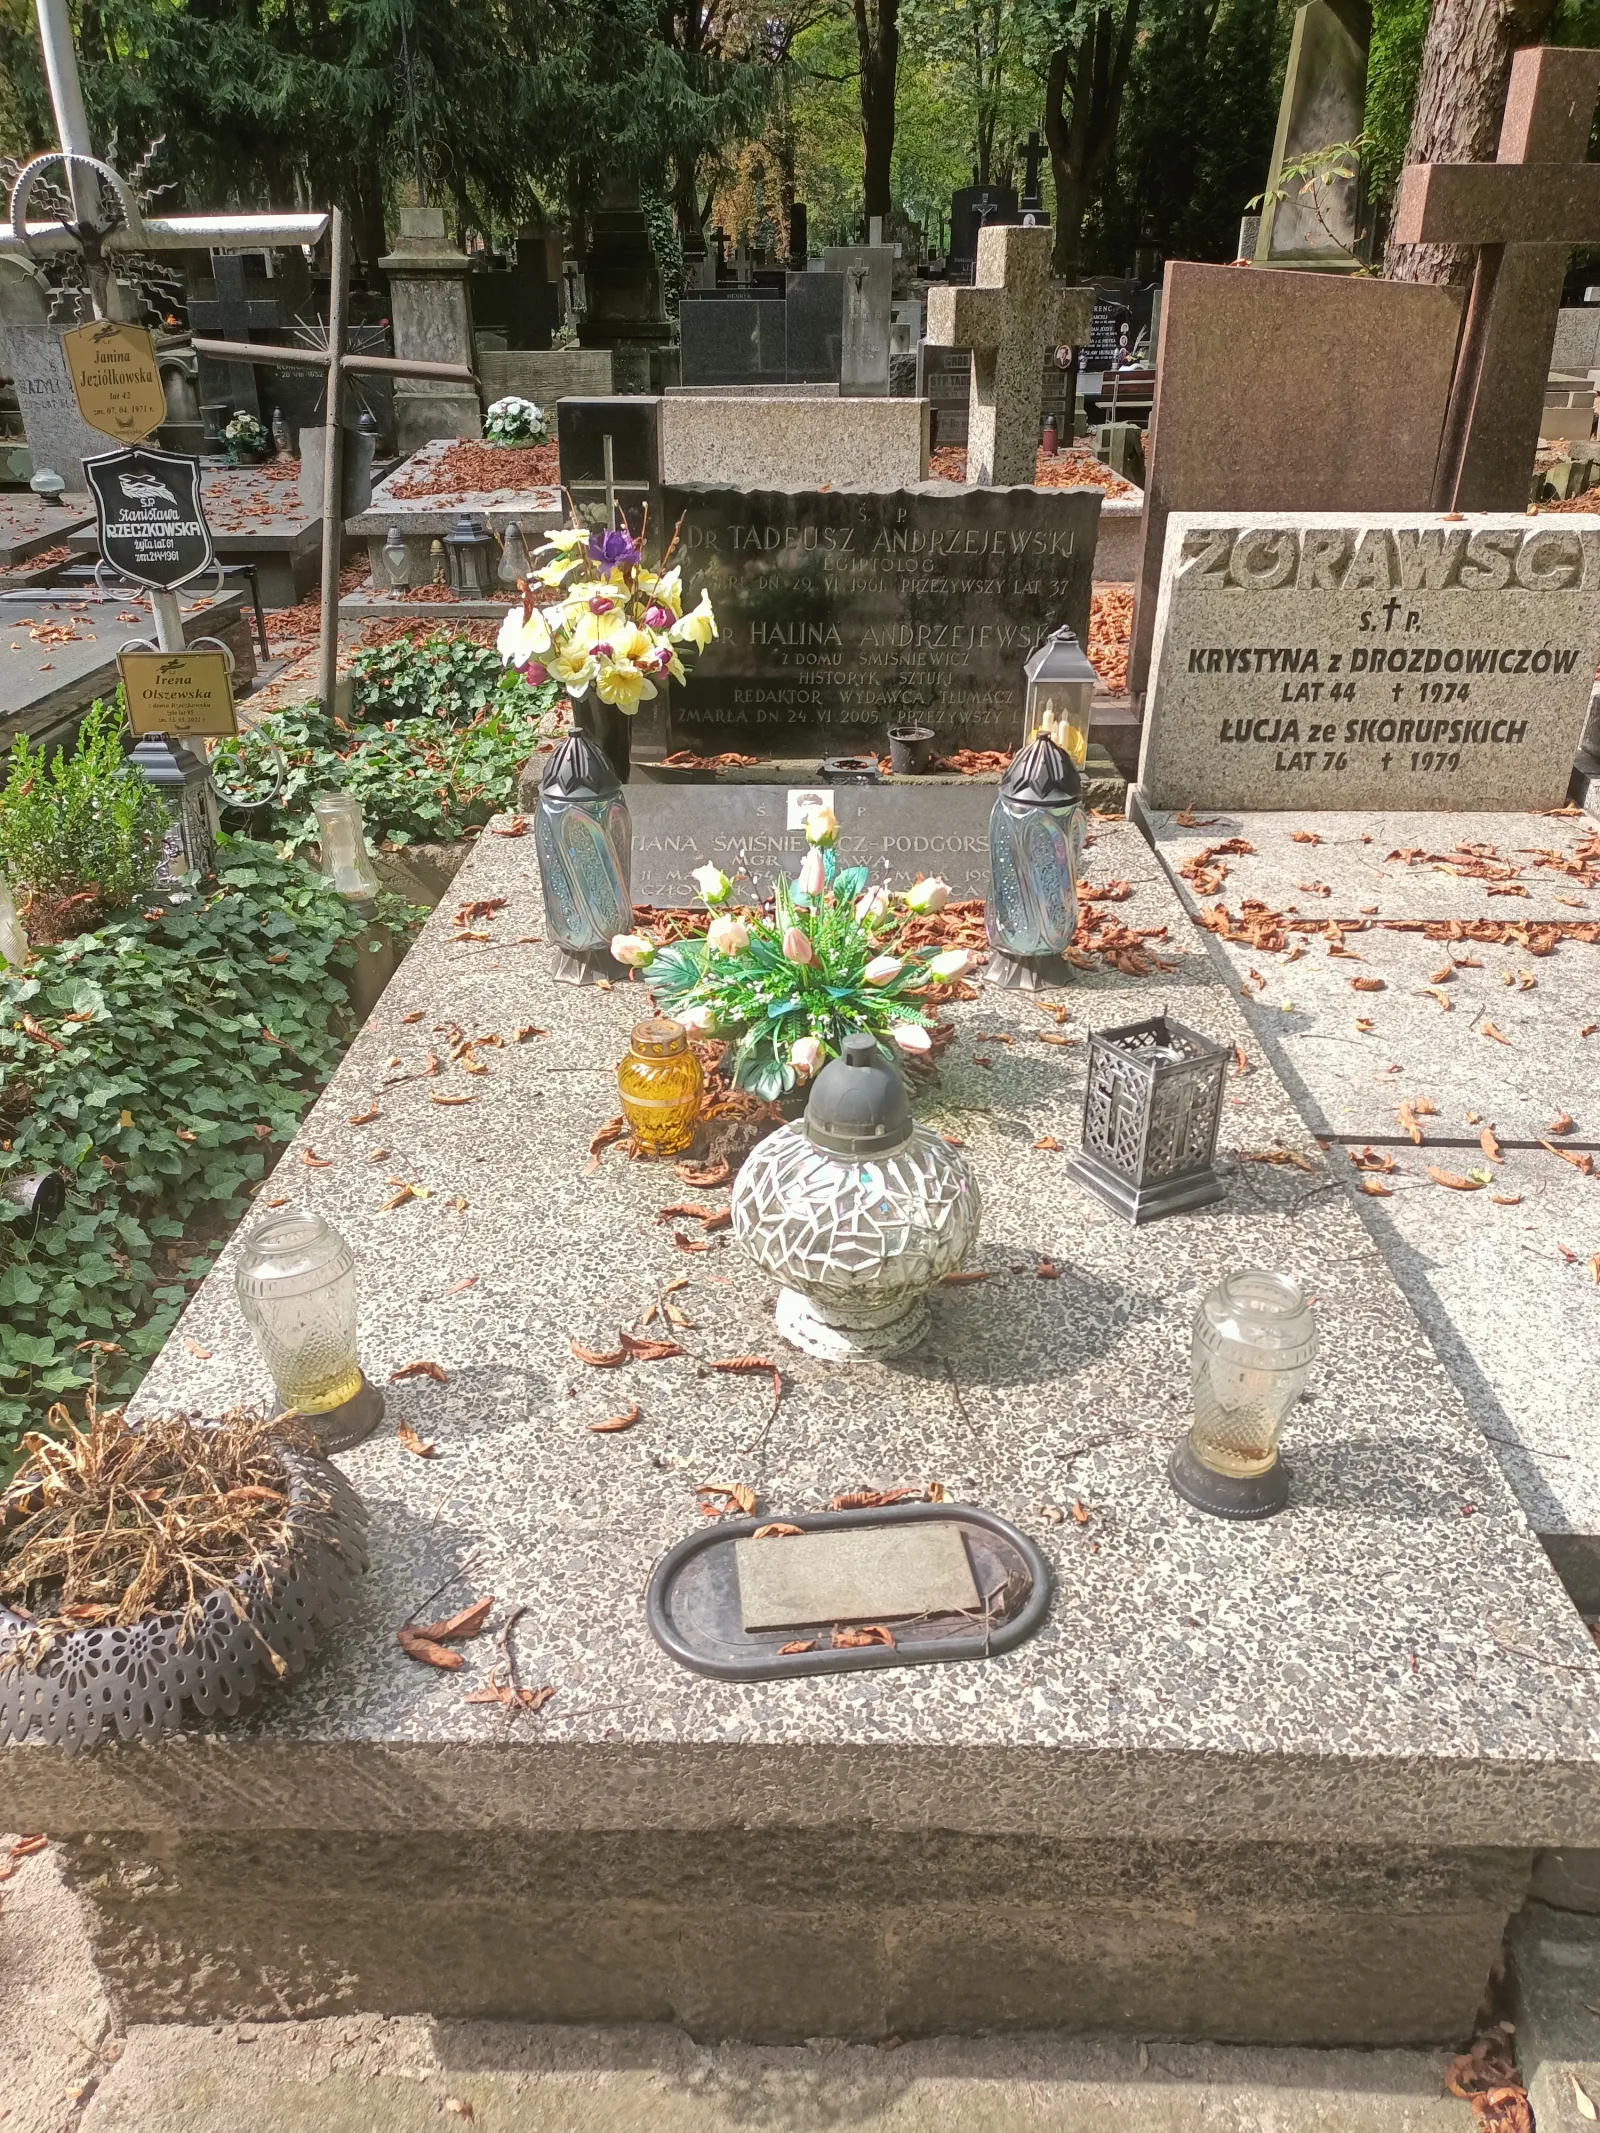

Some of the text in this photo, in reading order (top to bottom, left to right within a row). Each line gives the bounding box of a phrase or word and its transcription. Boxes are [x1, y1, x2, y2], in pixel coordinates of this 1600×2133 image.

[94, 350, 131, 364] Janina
[81, 368, 153, 387] Jeziółkowska
[109, 392, 120, 400] lat
[118, 507, 181, 521] Stanisława
[897, 508, 906, 523] P.
[106, 521, 201, 538] RZECZKOWSKA
[727, 525, 855, 552] TADEUSZ
[872, 526, 1076, 558] ANDRZEJEWSKI
[823, 557, 935, 574] EGIPTOLOG
[1013, 580, 1041, 595] LAT
[1049, 580, 1070, 598] 37
[1359, 603, 1421, 633] Ś. P.
[750, 620, 843, 646] HALINA
[860, 624, 1050, 651] ANDRZEJEWSK
[796, 653, 843, 666] DOMU
[859, 650, 970, 666] ŚMIŚNIEWICZ
[1188, 640, 1580, 674] KRYSTYNA z DROZDOWICZÓW
[155, 675, 192, 685] Irena
[798, 671, 952, 687] HISTORYK SZTUKI
[142, 689, 211, 700] Olszewska
[734, 689, 1013, 705] REDAKTOR WYDAWCA TŁUMACZ
[1281, 682, 1470, 703] LAT 44 1974
[678, 708, 749, 724] ZMARŁA
[1219, 718, 1529, 744] ŁUCJA ze SKORUPSKICH
[1275, 752, 1461, 772] LAT 76 1979
[714, 831, 991, 853] ŚMIŚNIECZ-PODGÓRS
[731, 855, 781, 866] MGR
[642, 884, 751, 897] CZŁOK
